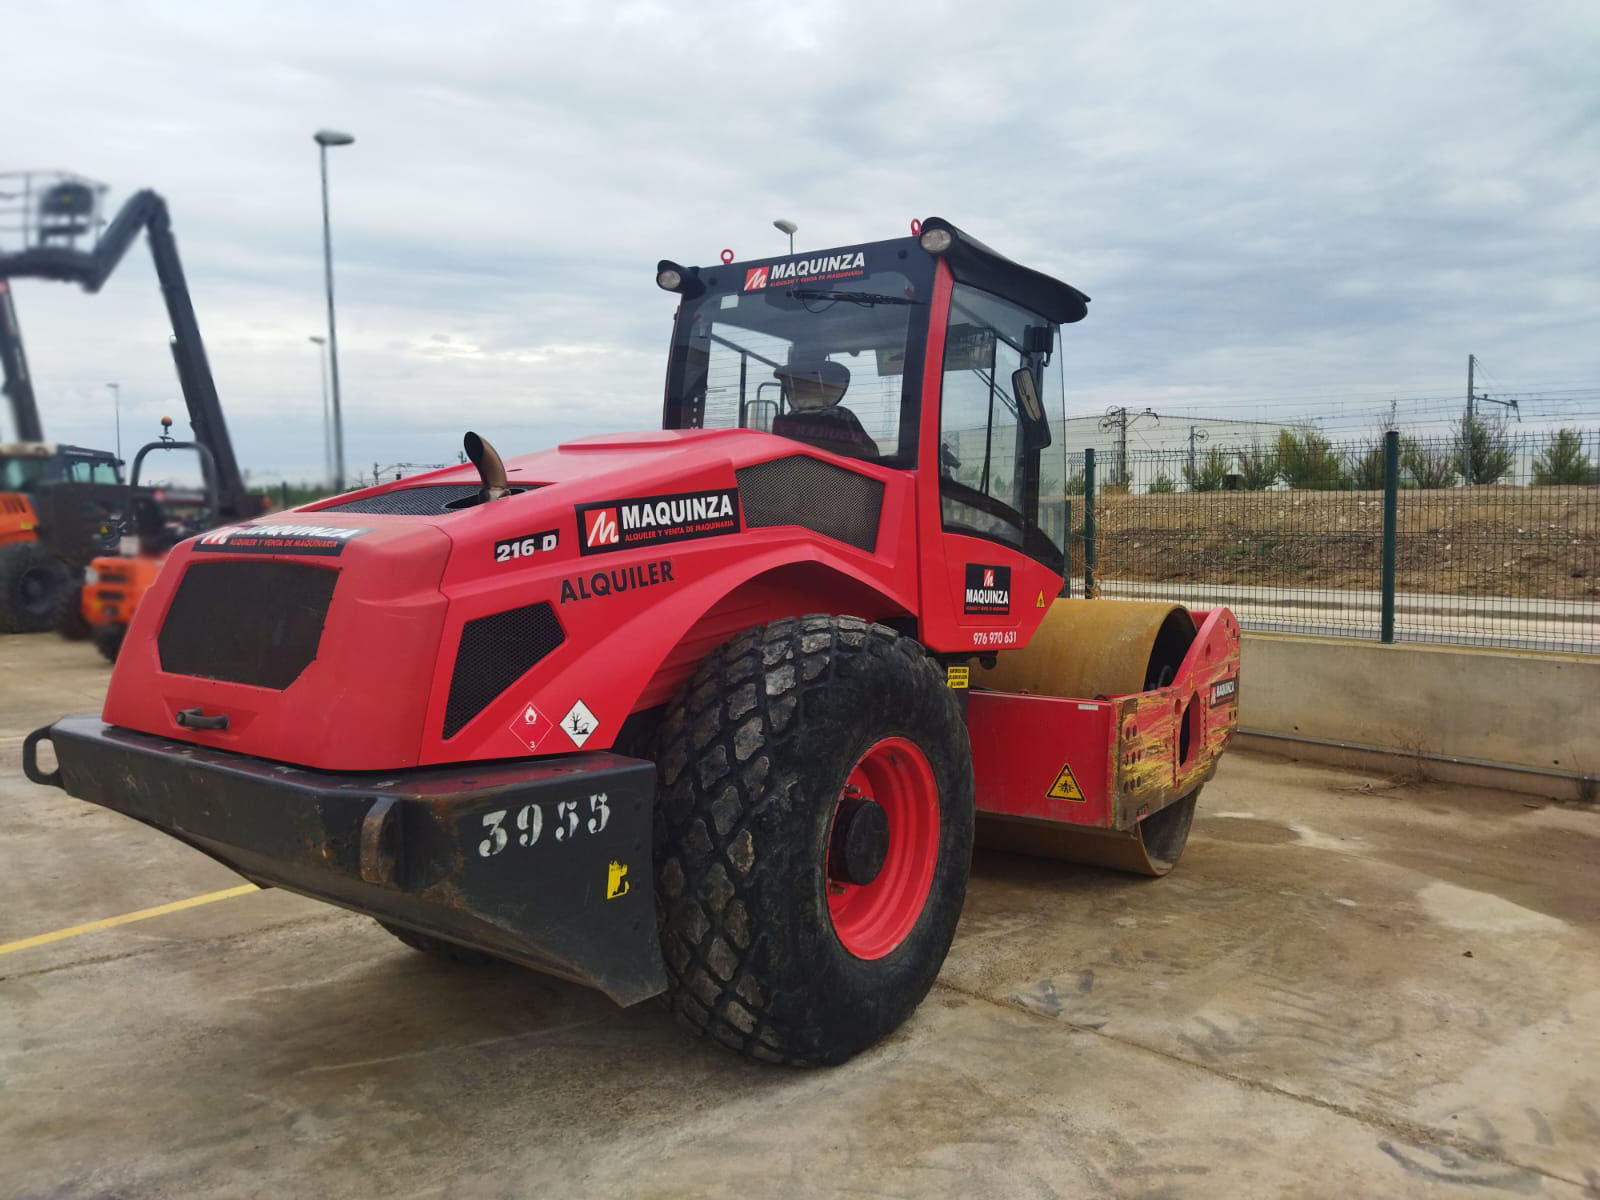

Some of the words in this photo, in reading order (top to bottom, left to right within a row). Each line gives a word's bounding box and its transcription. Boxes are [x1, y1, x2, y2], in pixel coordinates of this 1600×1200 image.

[770, 252, 865, 280] MAQUINZA
[621, 494, 734, 530] MAQUINZA
[625, 531, 657, 542] ALQUILER
[658, 529, 663, 537] Y
[664, 527, 685, 536] VENTA
[686, 525, 694, 533] DE
[695, 520, 735, 532] MAQUINARIA
[496, 538, 535, 563] 216
[542, 534, 557, 552] D
[560, 560, 675, 604] ALQUILER
[965, 589, 1009, 605] MAQUINZA
[973, 632, 988, 645] 976
[989, 631, 1003, 644] 970
[1004, 631, 1017, 644] 631
[530, 740, 536, 749] 3
[478, 792, 611, 858] 3955
